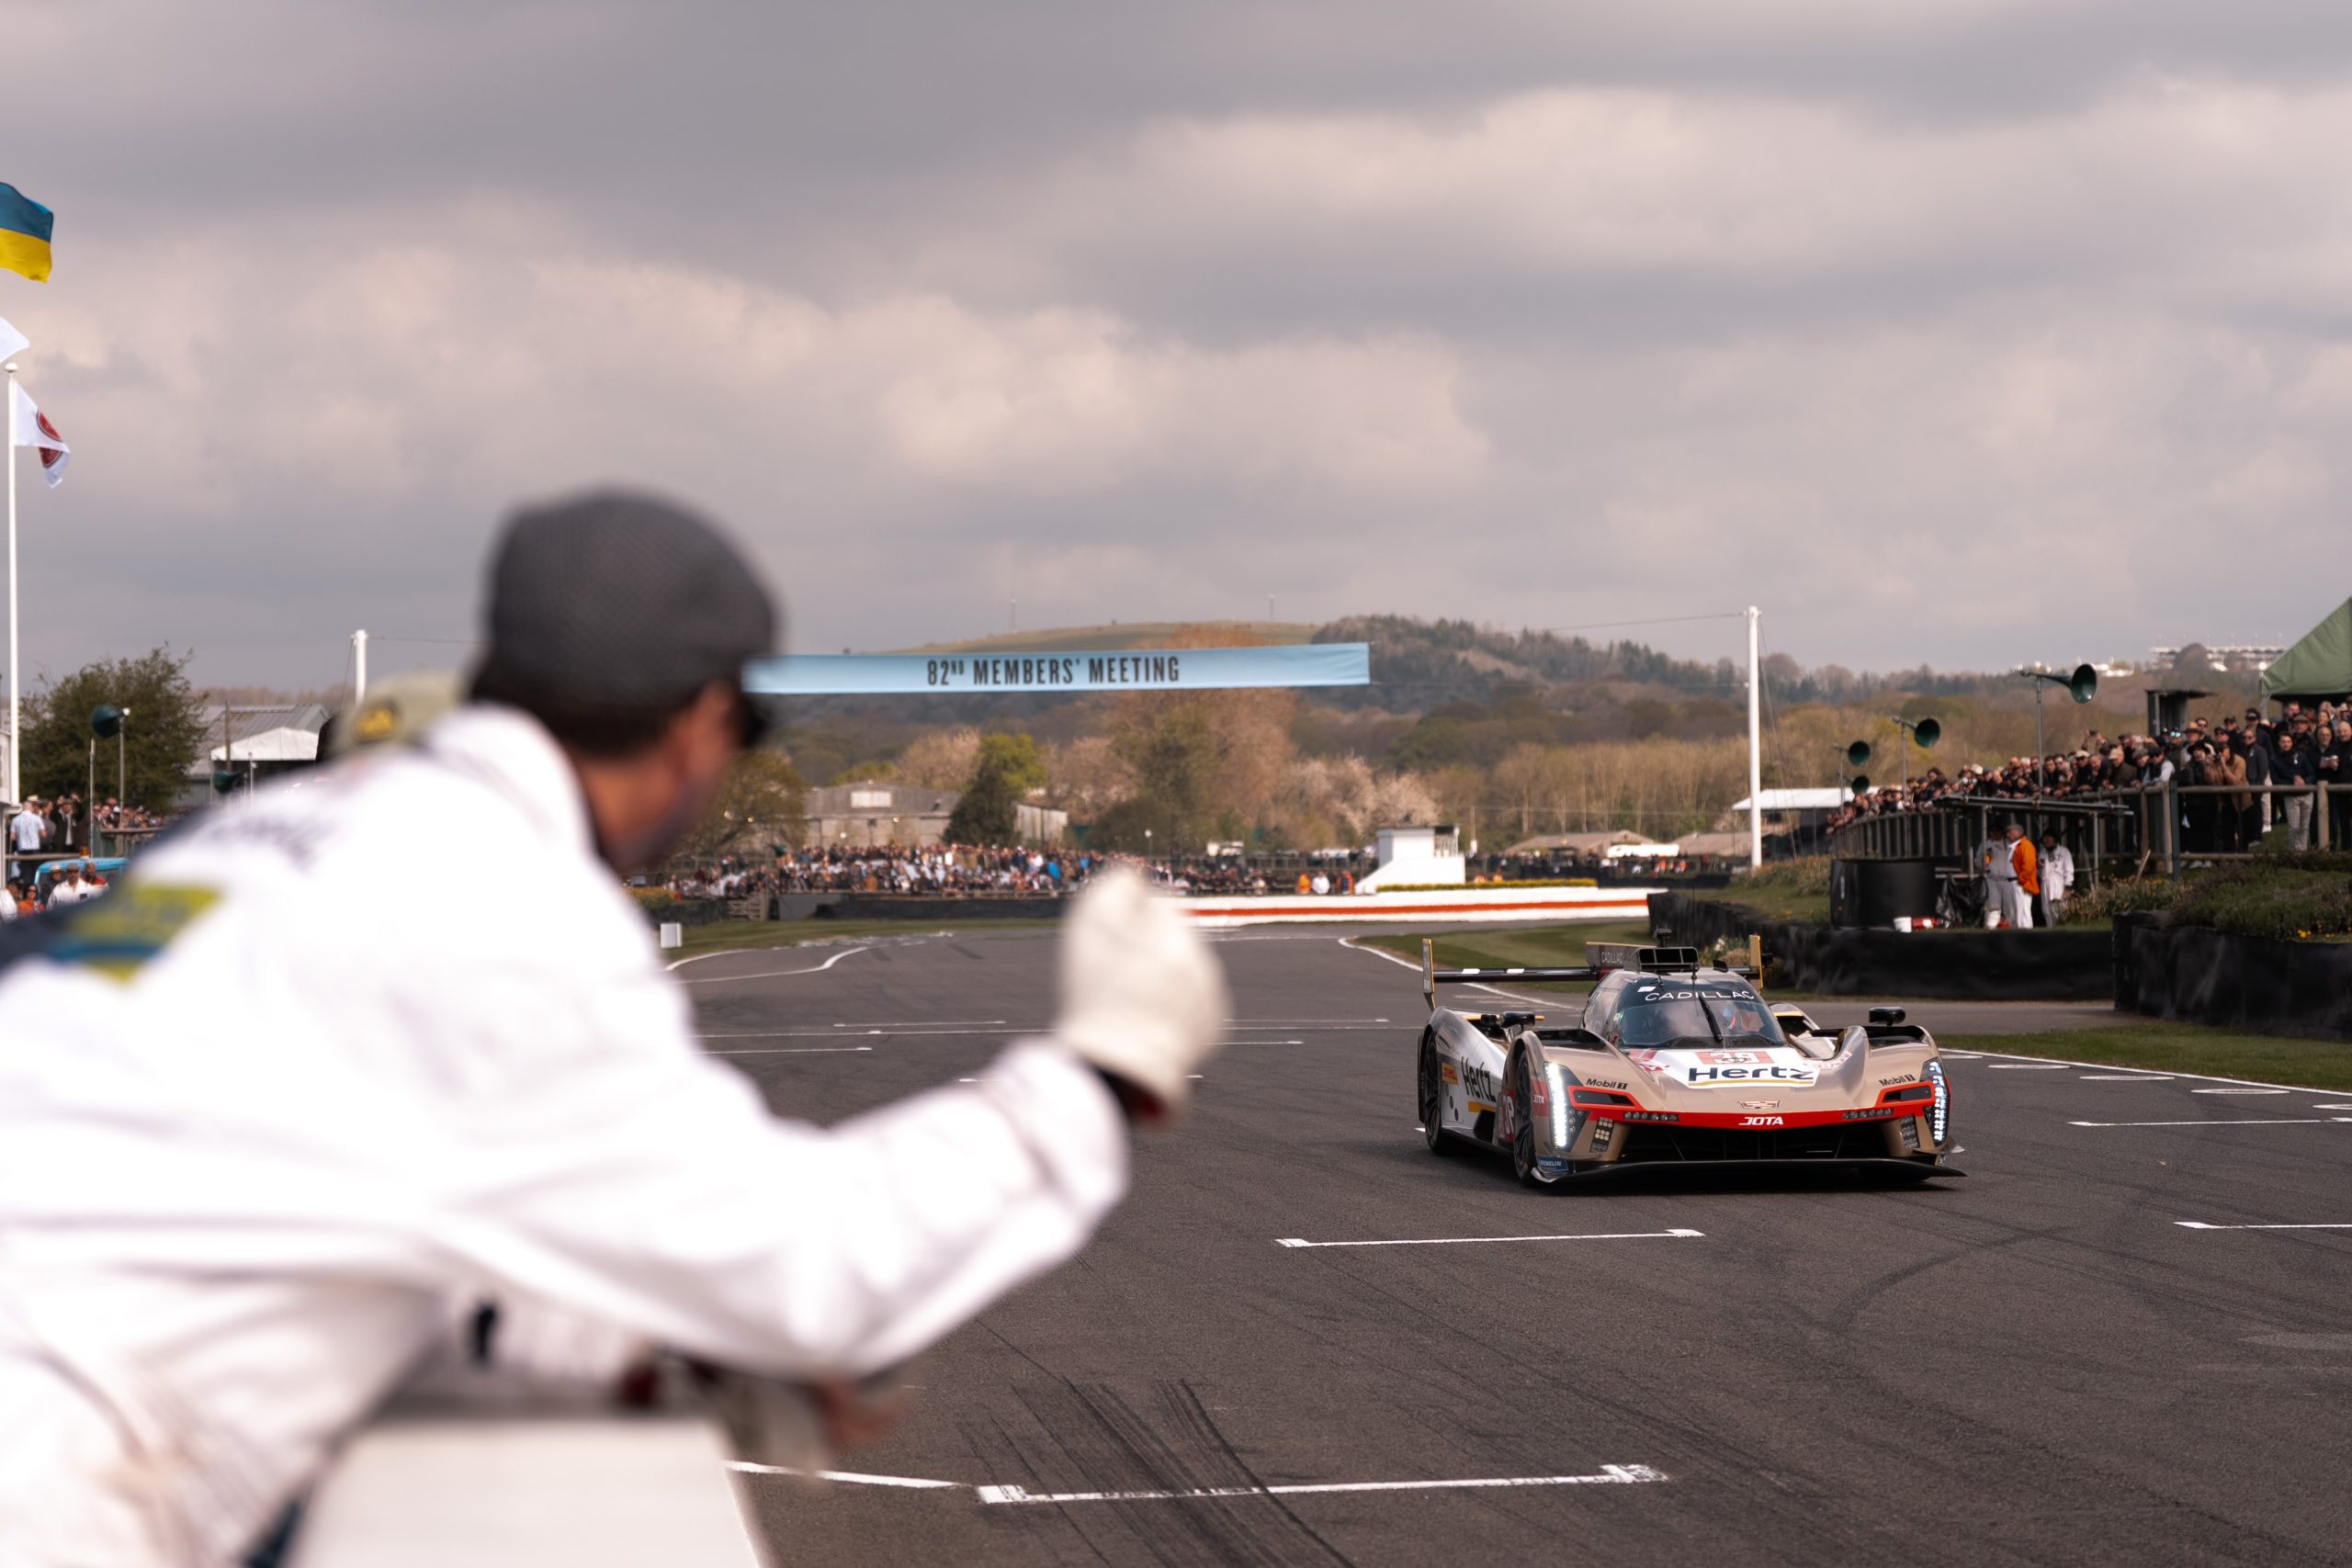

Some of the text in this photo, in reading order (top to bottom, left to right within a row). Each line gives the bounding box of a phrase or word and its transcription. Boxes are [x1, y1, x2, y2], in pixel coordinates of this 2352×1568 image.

[973, 658, 1080, 685] MEMBERS'
[1089, 656, 1180, 683] MEETING
[1645, 990, 1755, 1001] CADILLAC
[1461, 1056, 1497, 1102] Hertz
[1688, 1066, 1815, 1081] Hertz
[1586, 1078, 1617, 1089] Mobil
[1879, 1076, 1905, 1087] Mobil
[1738, 1116, 1784, 1126] JOTA
